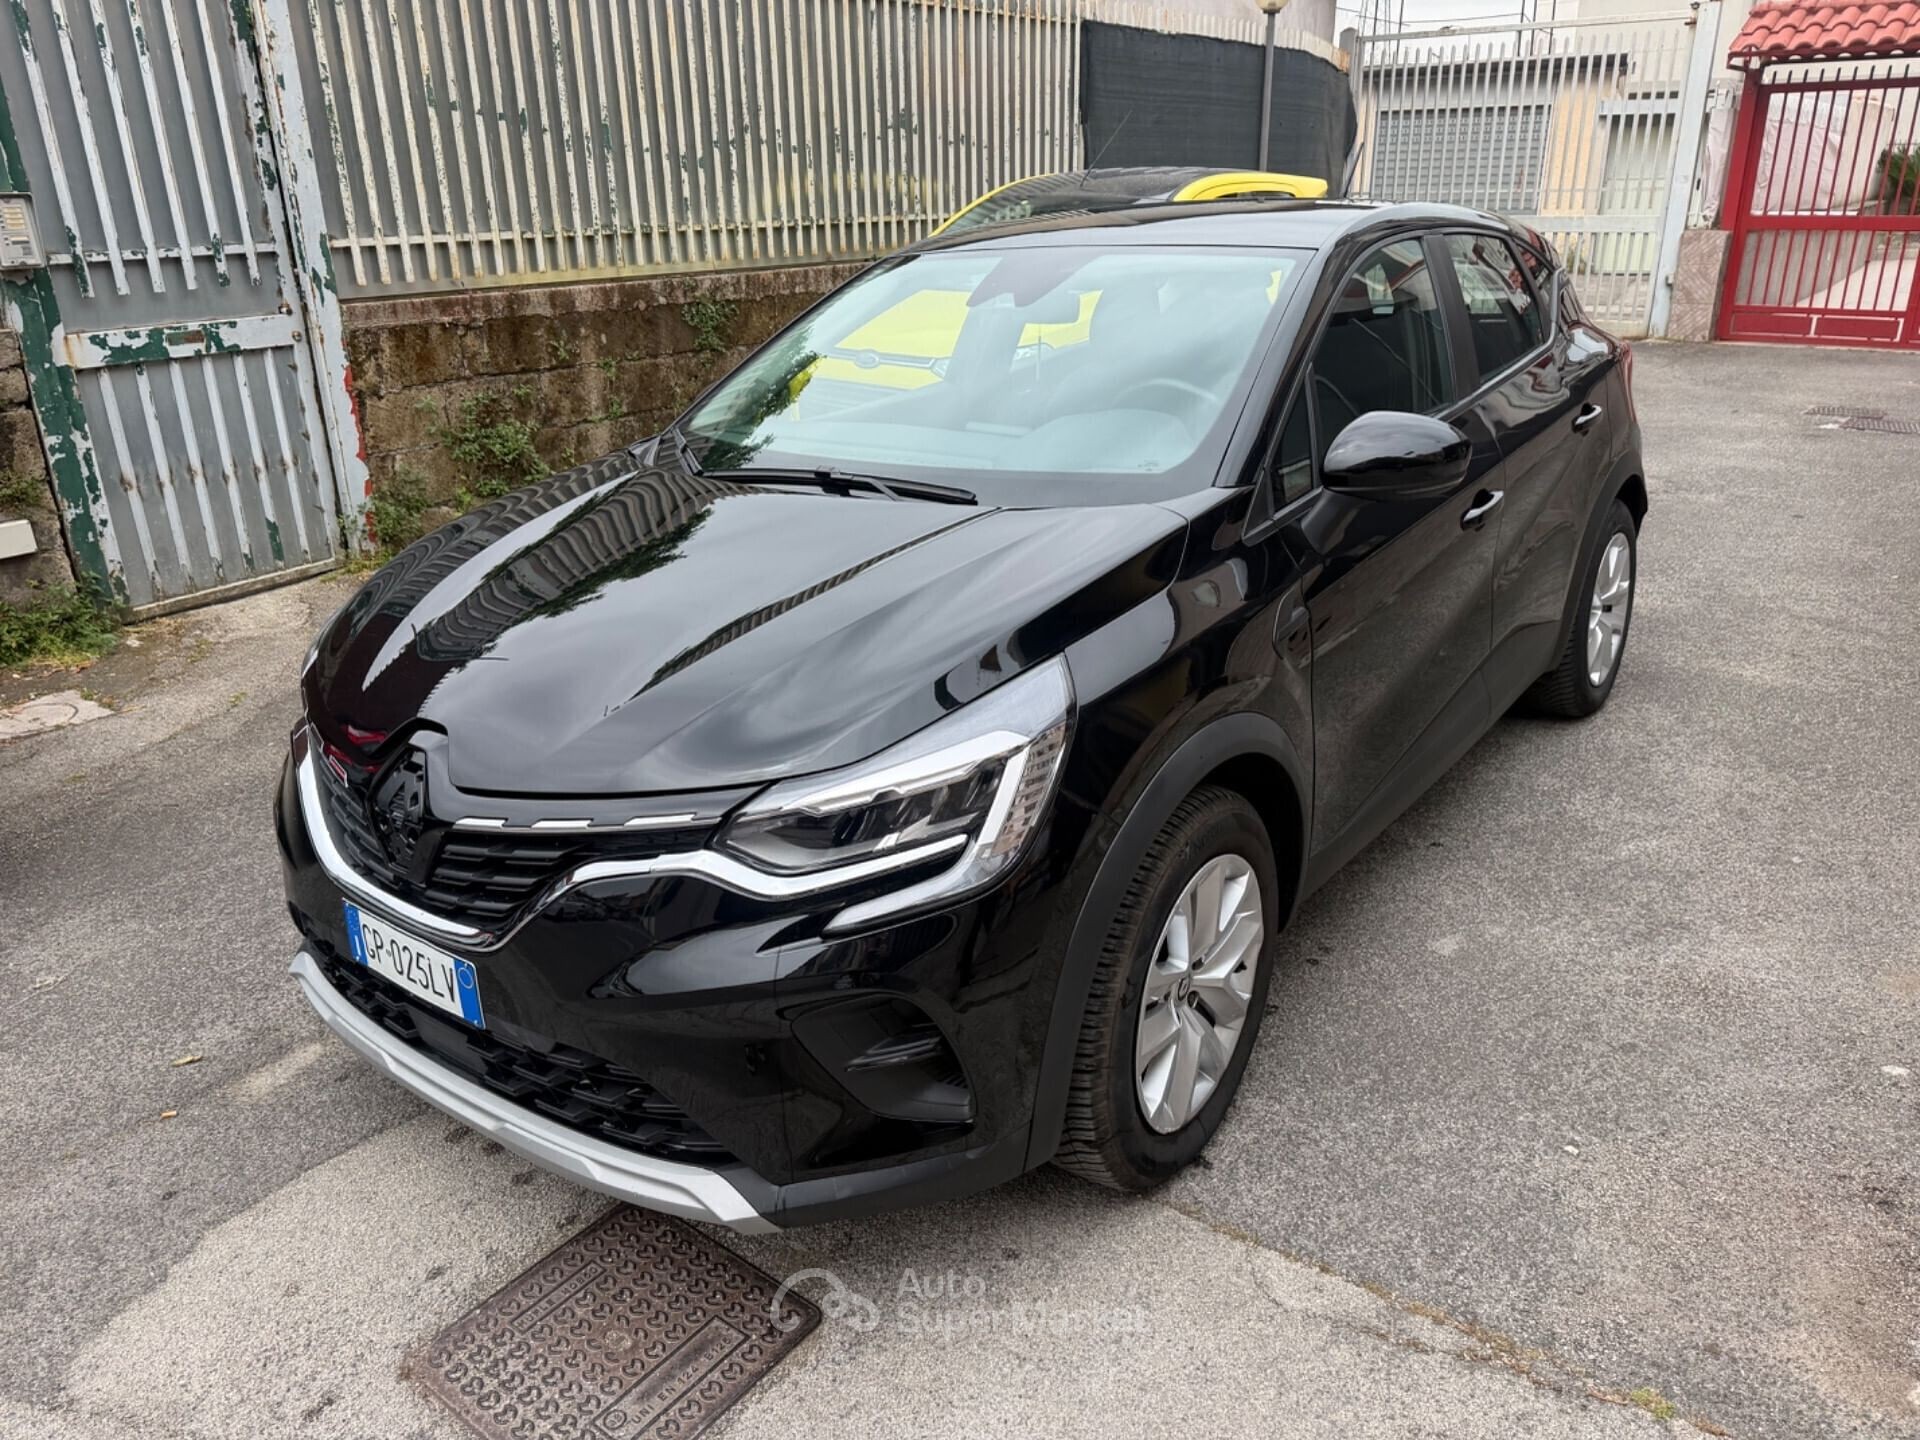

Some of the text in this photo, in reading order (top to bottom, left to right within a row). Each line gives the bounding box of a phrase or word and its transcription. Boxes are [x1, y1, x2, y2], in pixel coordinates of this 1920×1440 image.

[631, 1404, 655, 1424] UNI
[657, 1385, 677, 1402] EN
[677, 1365, 699, 1385] 124
